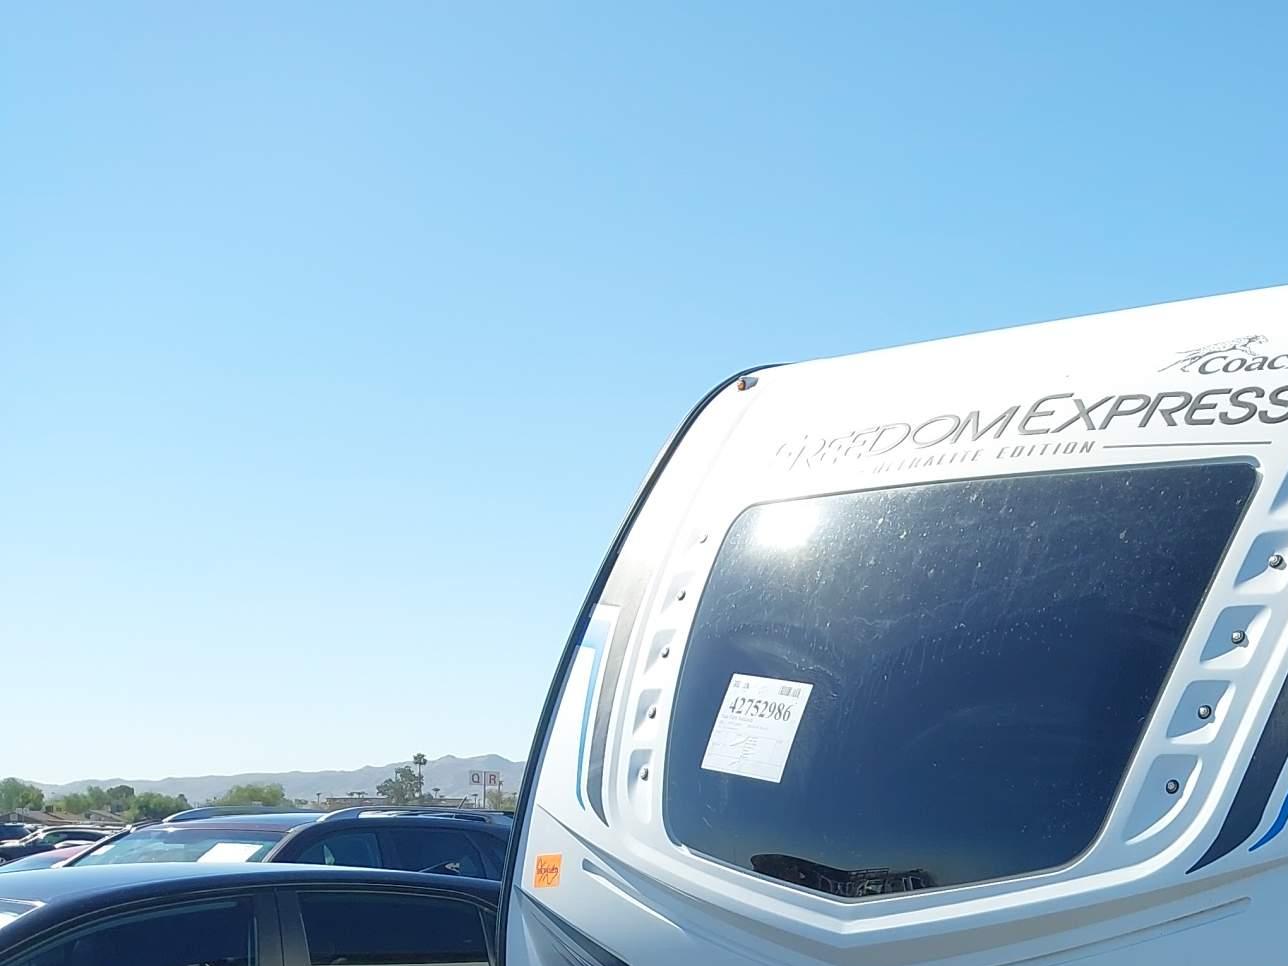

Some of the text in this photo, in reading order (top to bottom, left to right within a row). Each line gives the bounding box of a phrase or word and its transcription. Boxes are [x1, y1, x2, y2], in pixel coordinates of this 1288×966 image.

[996, 440, 1097, 460] EDITION
[729, 696, 794, 722] 42752986
[471, 773, 480, 784] Q
[488, 774, 497, 785] R
